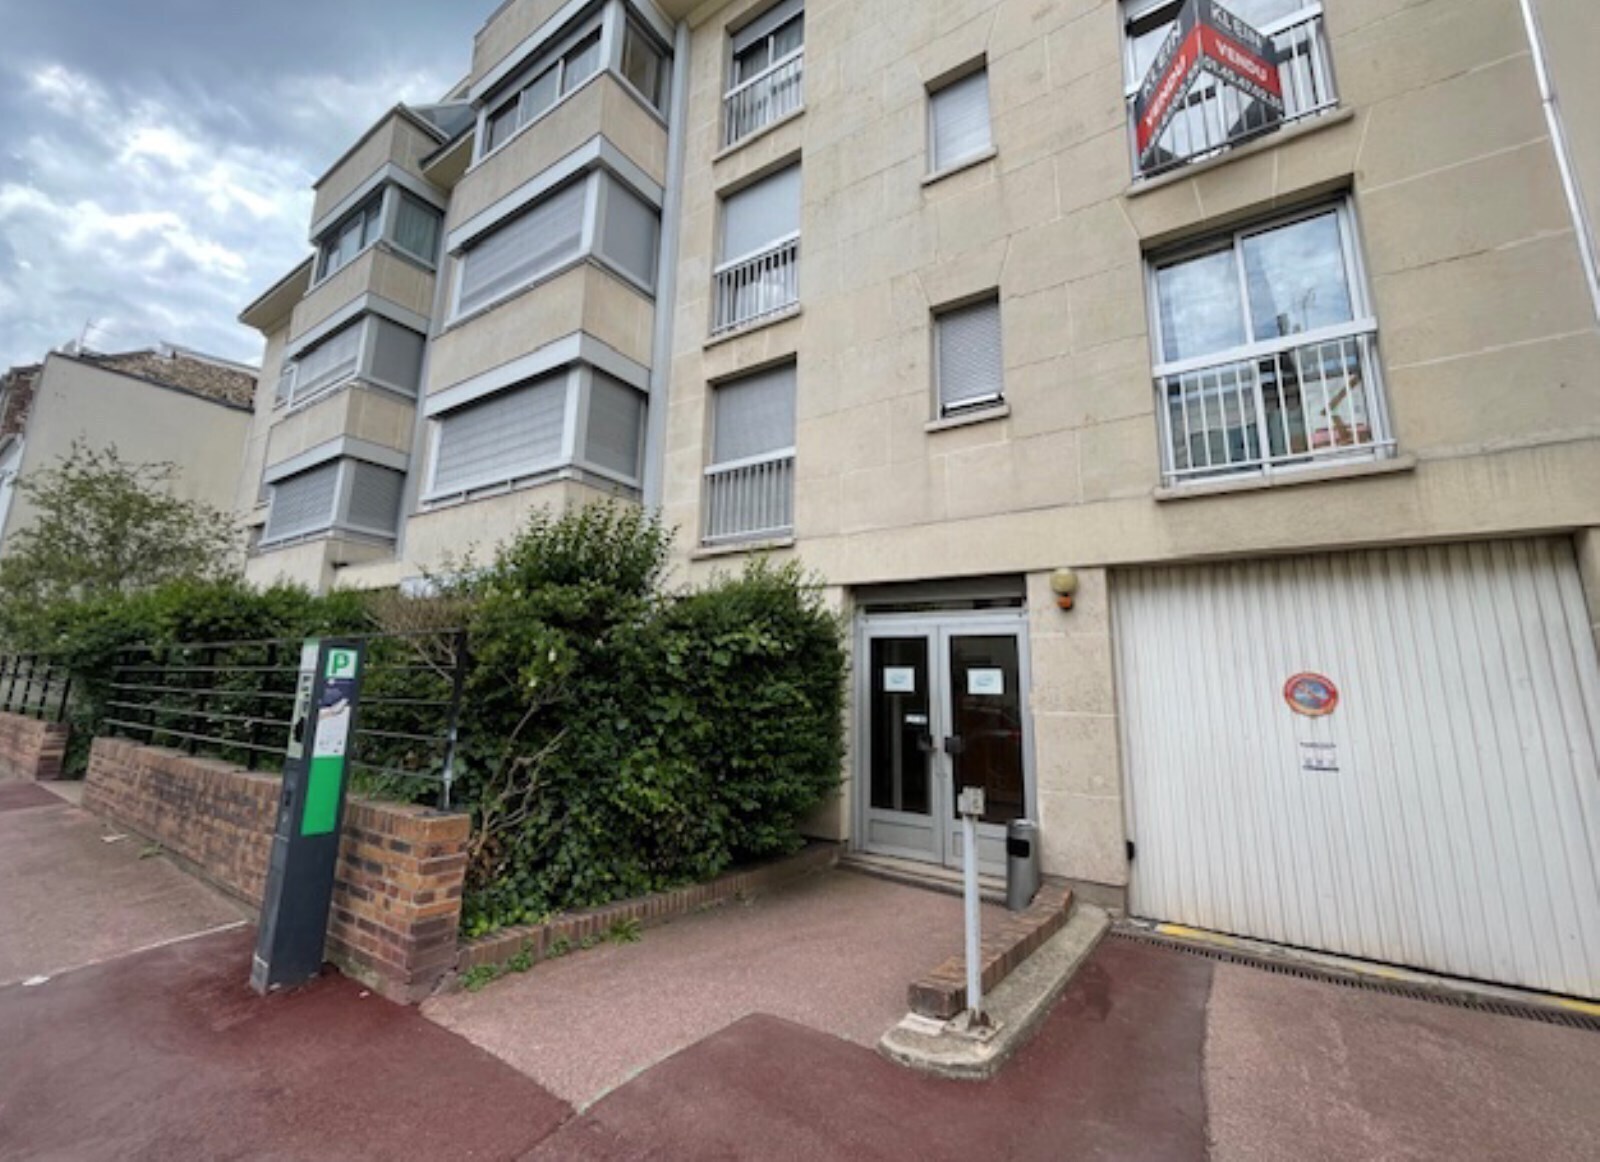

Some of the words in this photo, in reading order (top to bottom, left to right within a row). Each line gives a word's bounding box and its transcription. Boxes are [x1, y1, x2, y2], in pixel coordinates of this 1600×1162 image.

[1215, 39, 1267, 81] VENDU
[1146, 54, 1187, 126] VENDU
[332, 653, 350, 674] P
